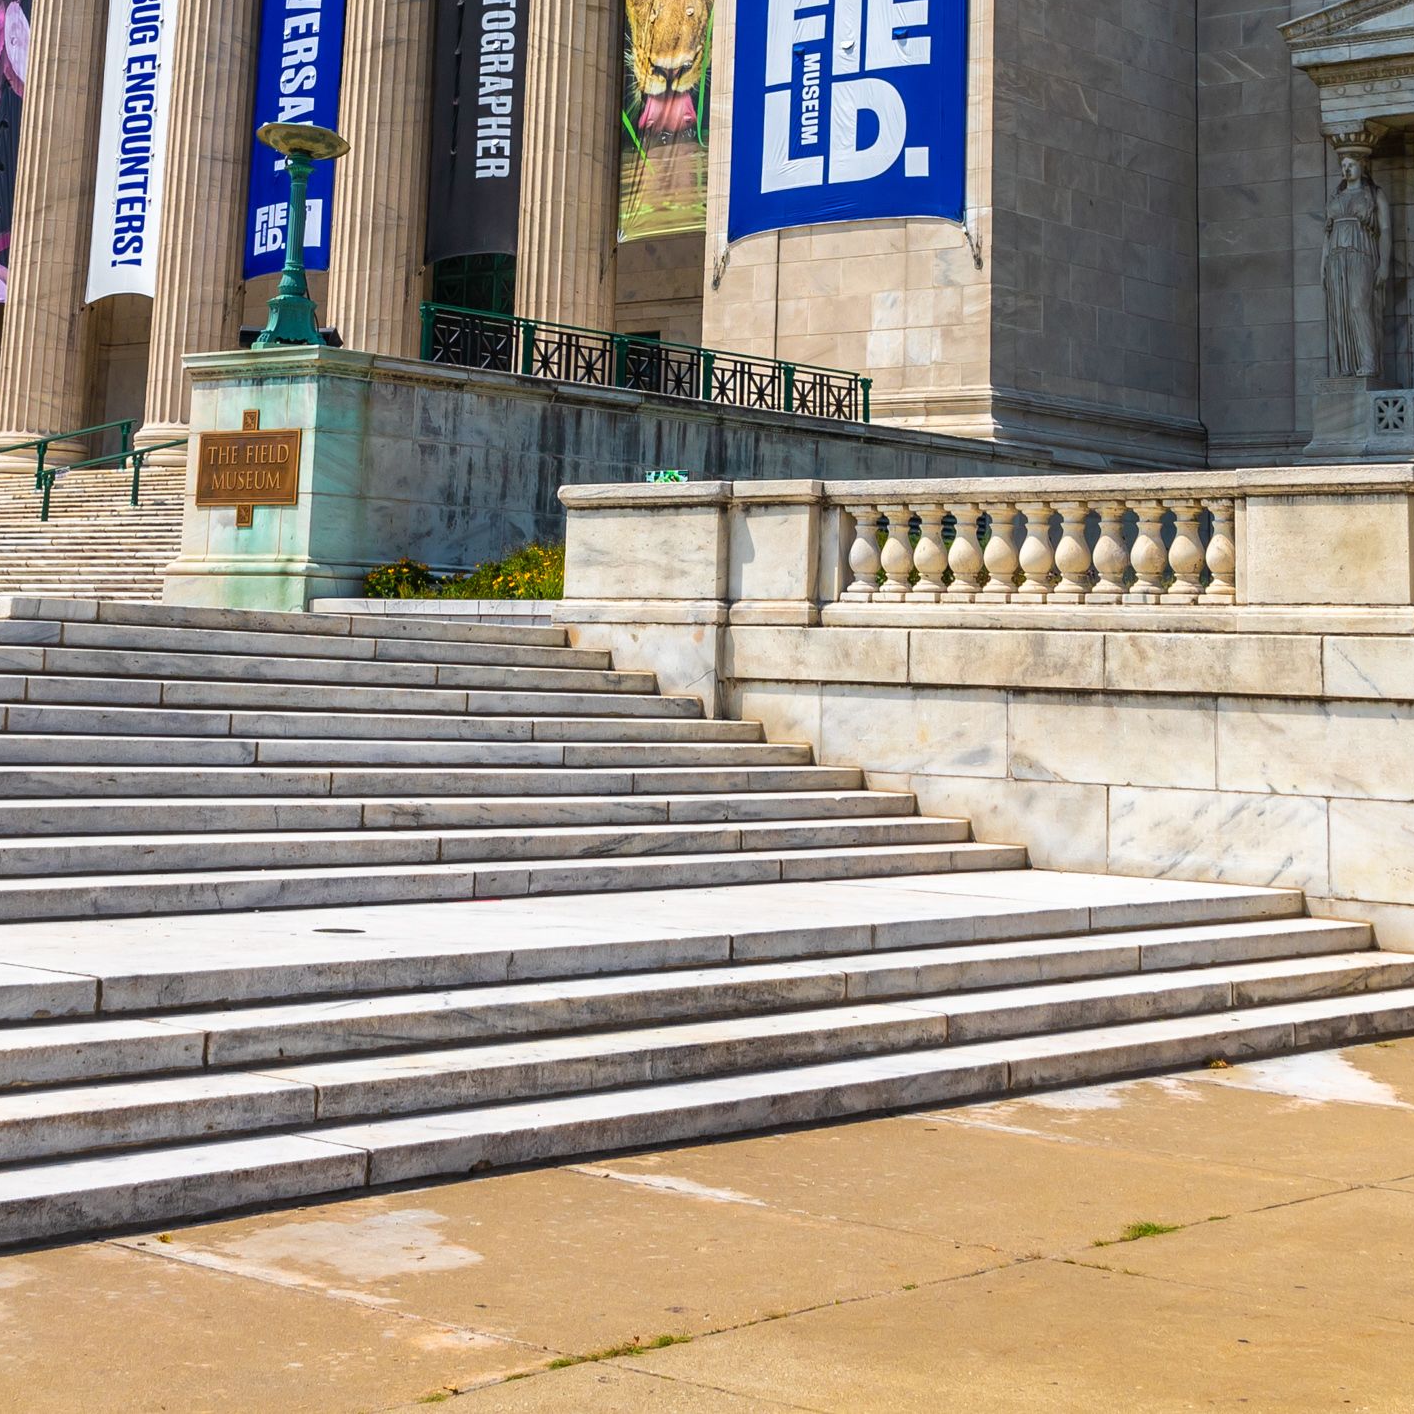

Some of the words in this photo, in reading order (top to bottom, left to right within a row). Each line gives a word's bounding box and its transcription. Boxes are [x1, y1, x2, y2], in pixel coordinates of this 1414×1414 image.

[801, 53, 821, 145] MUSEUM
[111, 54, 158, 268] ENCOUNTERS!
[208, 446, 239, 465] THE
[246, 444, 290, 464] FIELD
[211, 470, 281, 490] MUSEUM
